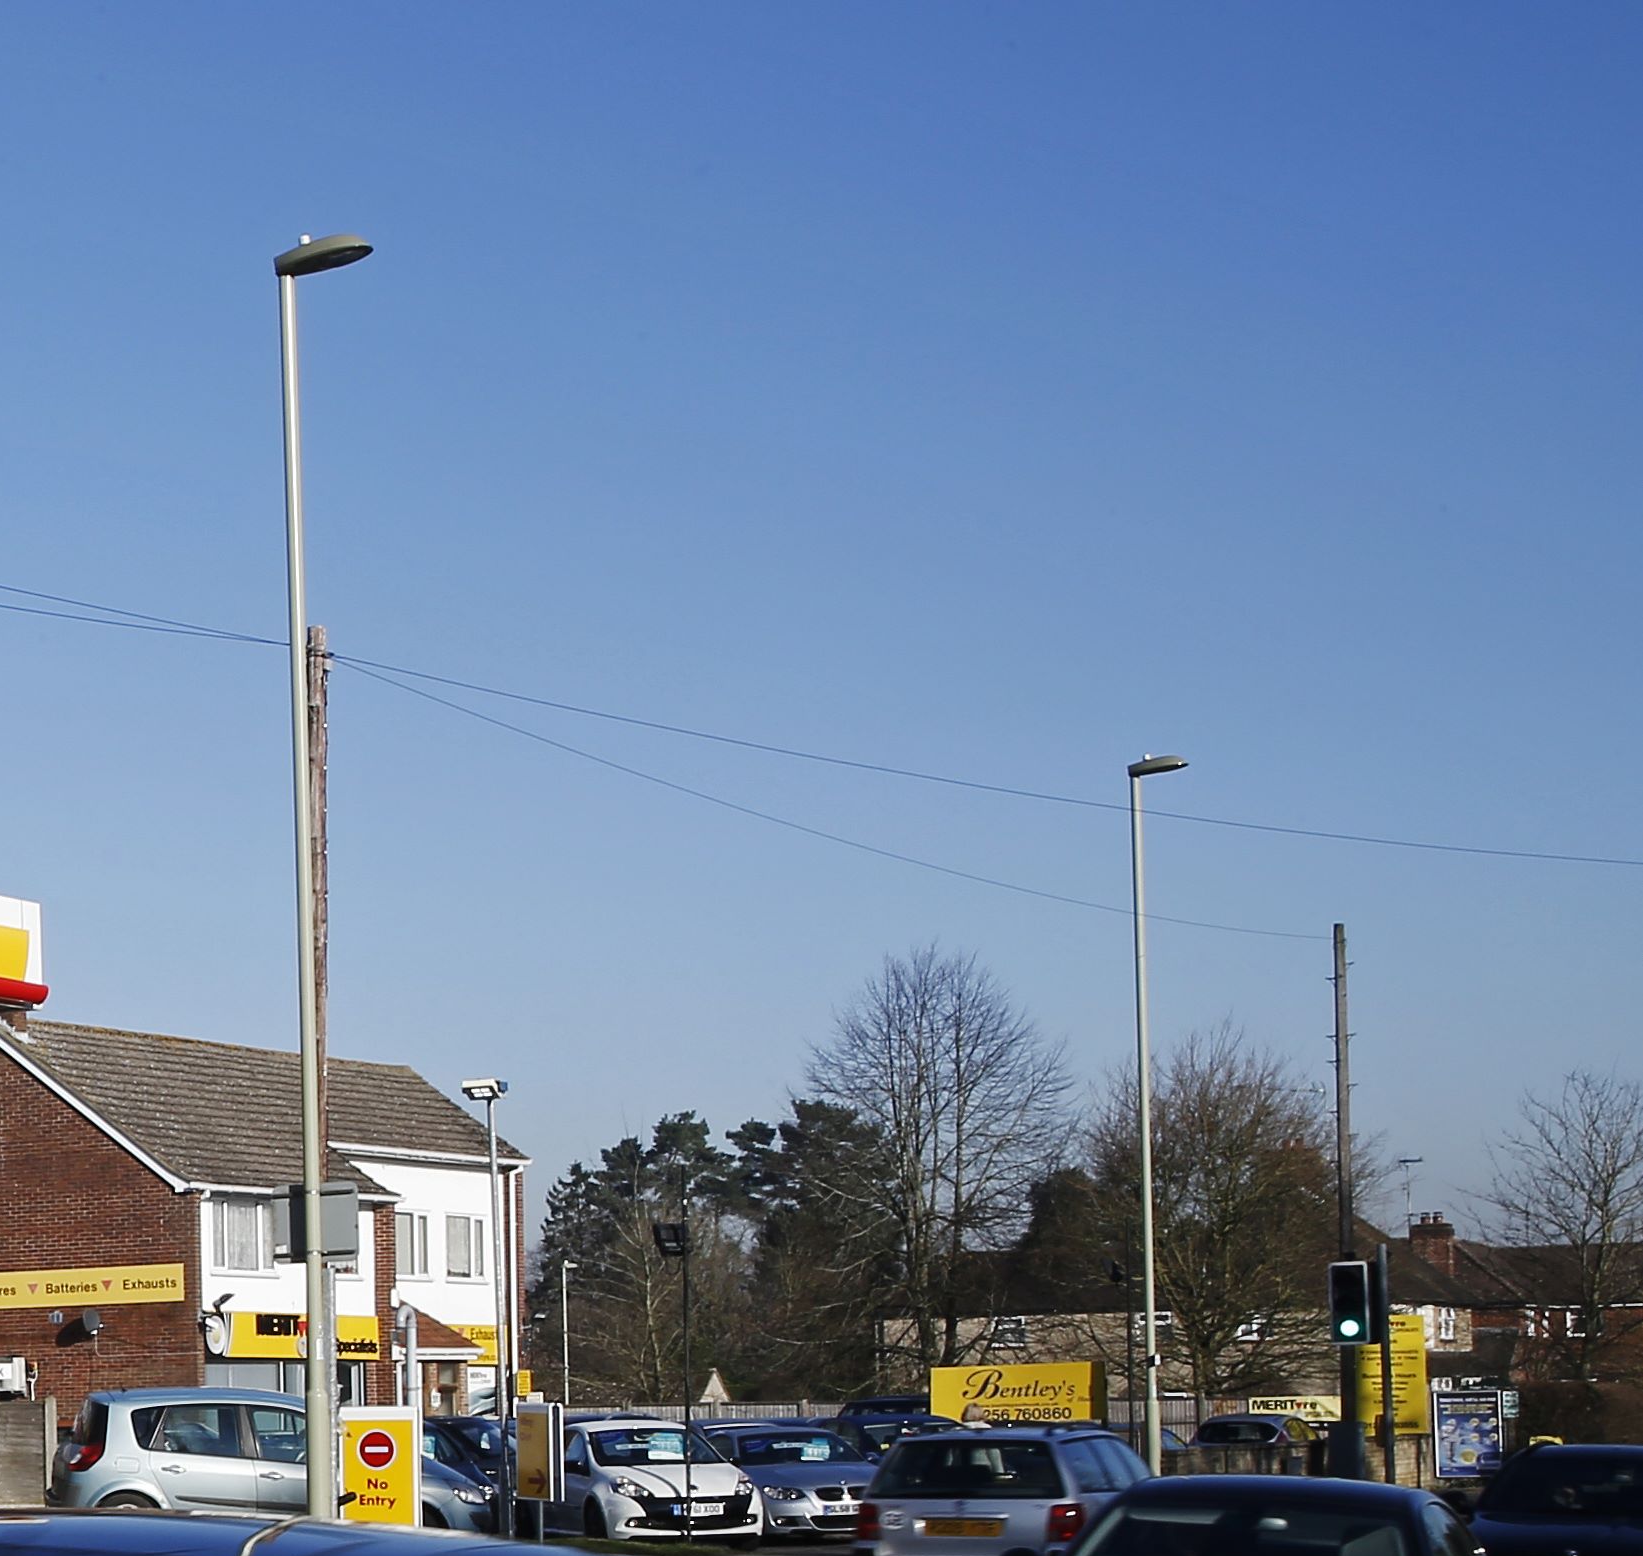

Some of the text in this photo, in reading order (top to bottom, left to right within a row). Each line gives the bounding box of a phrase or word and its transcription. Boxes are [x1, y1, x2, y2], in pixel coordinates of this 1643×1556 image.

[46, 1281, 98, 1295] Batteries
[122, 1277, 177, 1291] Exhausts
[962, 1368, 1075, 1401] Bentley's
[983, 1407, 1072, 1421] 256 760860
[367, 1478, 389, 1490] No
[359, 1494, 396, 1509] Entry
